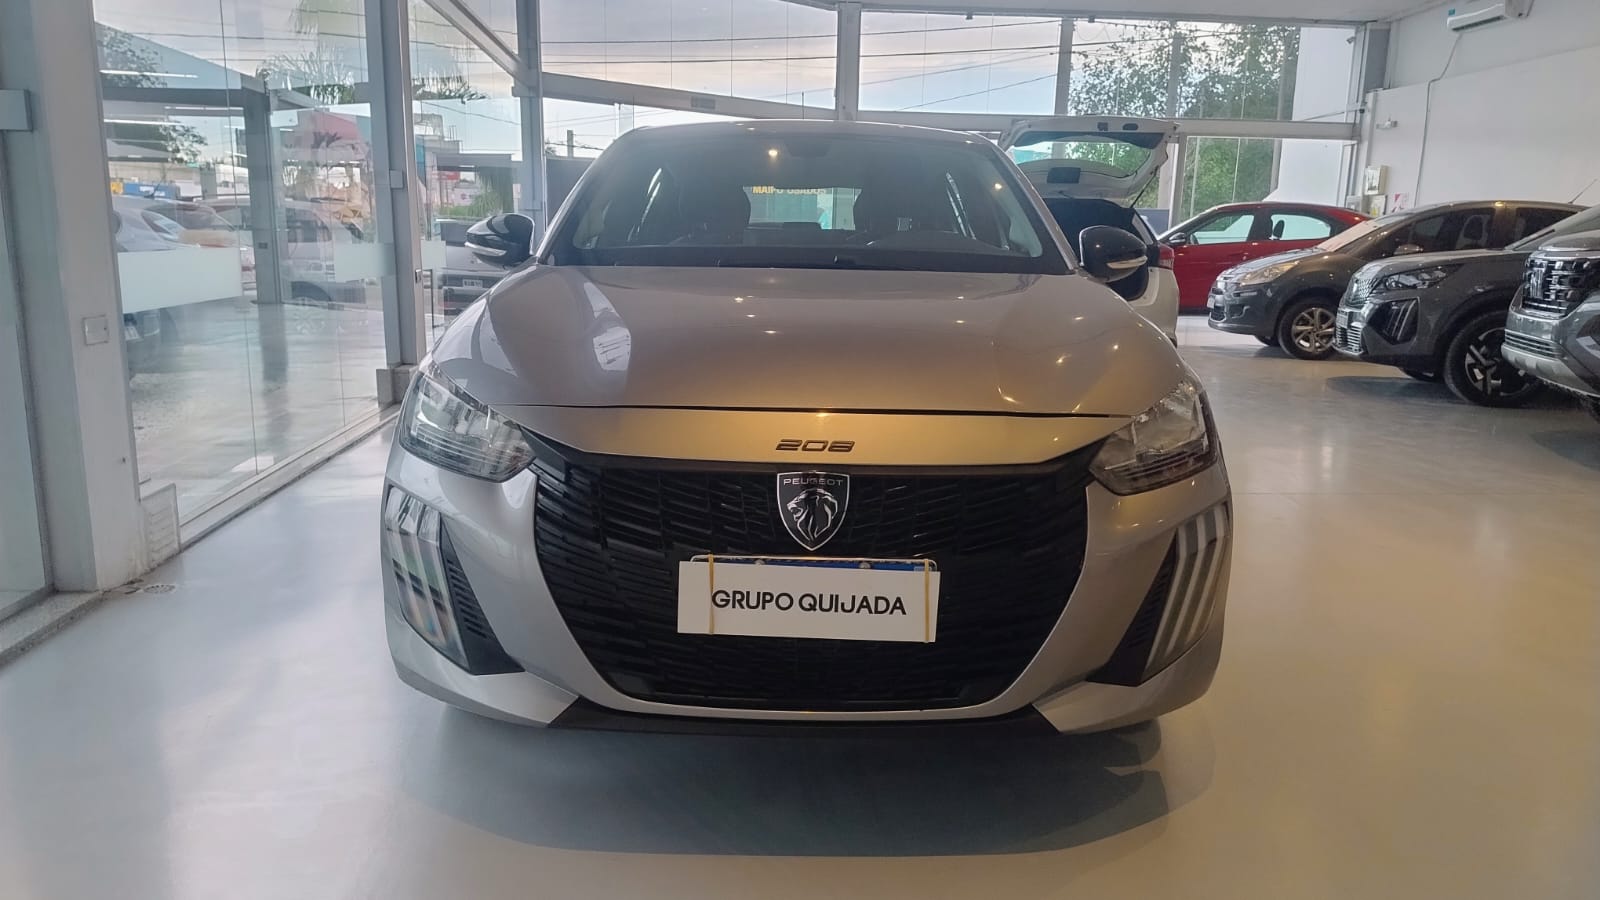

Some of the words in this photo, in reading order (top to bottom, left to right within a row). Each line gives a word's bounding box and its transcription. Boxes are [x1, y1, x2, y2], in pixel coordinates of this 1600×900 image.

[776, 439, 855, 452] 208
[783, 478, 843, 486] PEUGEOT
[711, 589, 794, 611] GRUPO
[798, 592, 906, 615] QUIJADA
